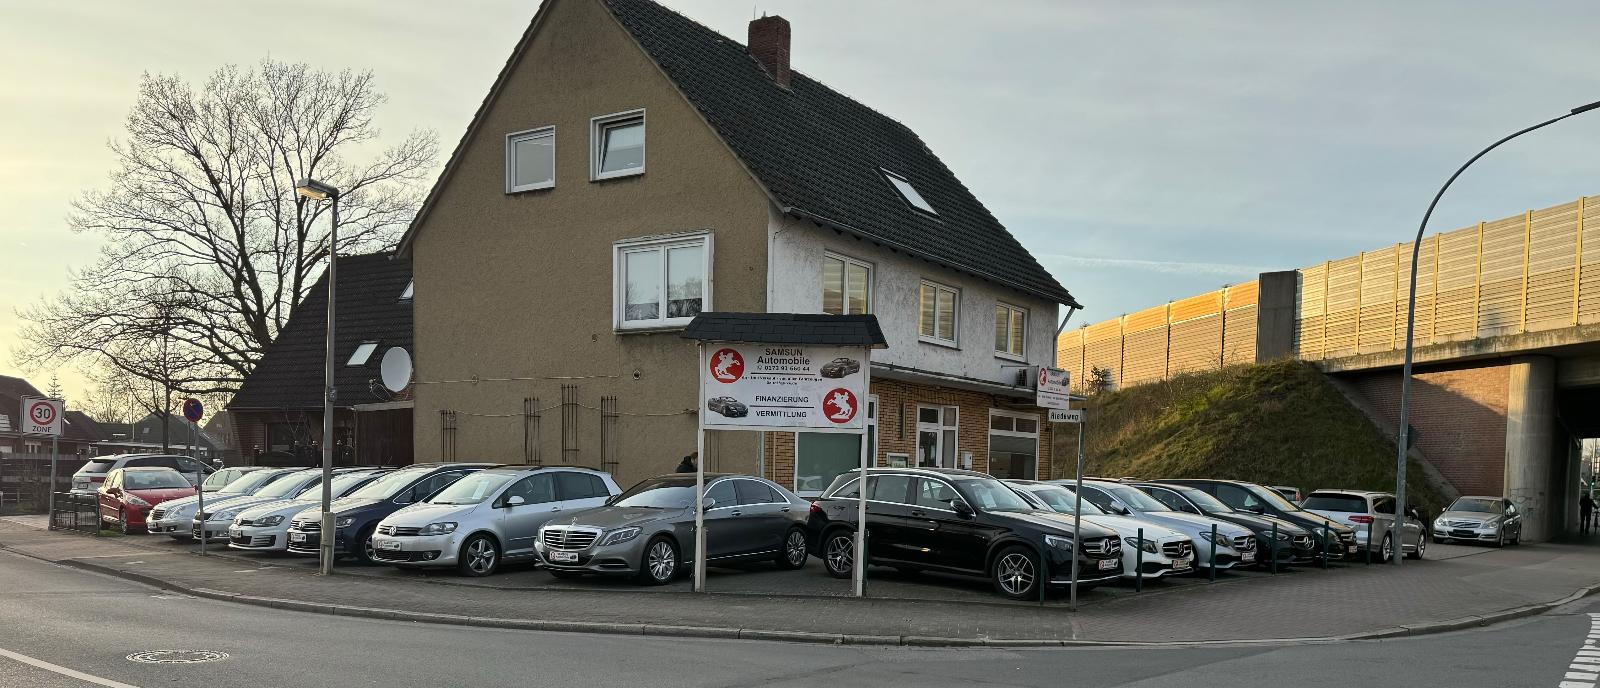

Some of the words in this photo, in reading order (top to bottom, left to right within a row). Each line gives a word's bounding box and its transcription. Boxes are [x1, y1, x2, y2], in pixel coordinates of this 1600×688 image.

[765, 348, 803, 356] SAMSUN
[757, 356, 810, 365] Automobile
[755, 395, 809, 403] FINANZIERUNG
[35, 408, 51, 419] 30
[756, 410, 807, 418] VERMITTLUNG
